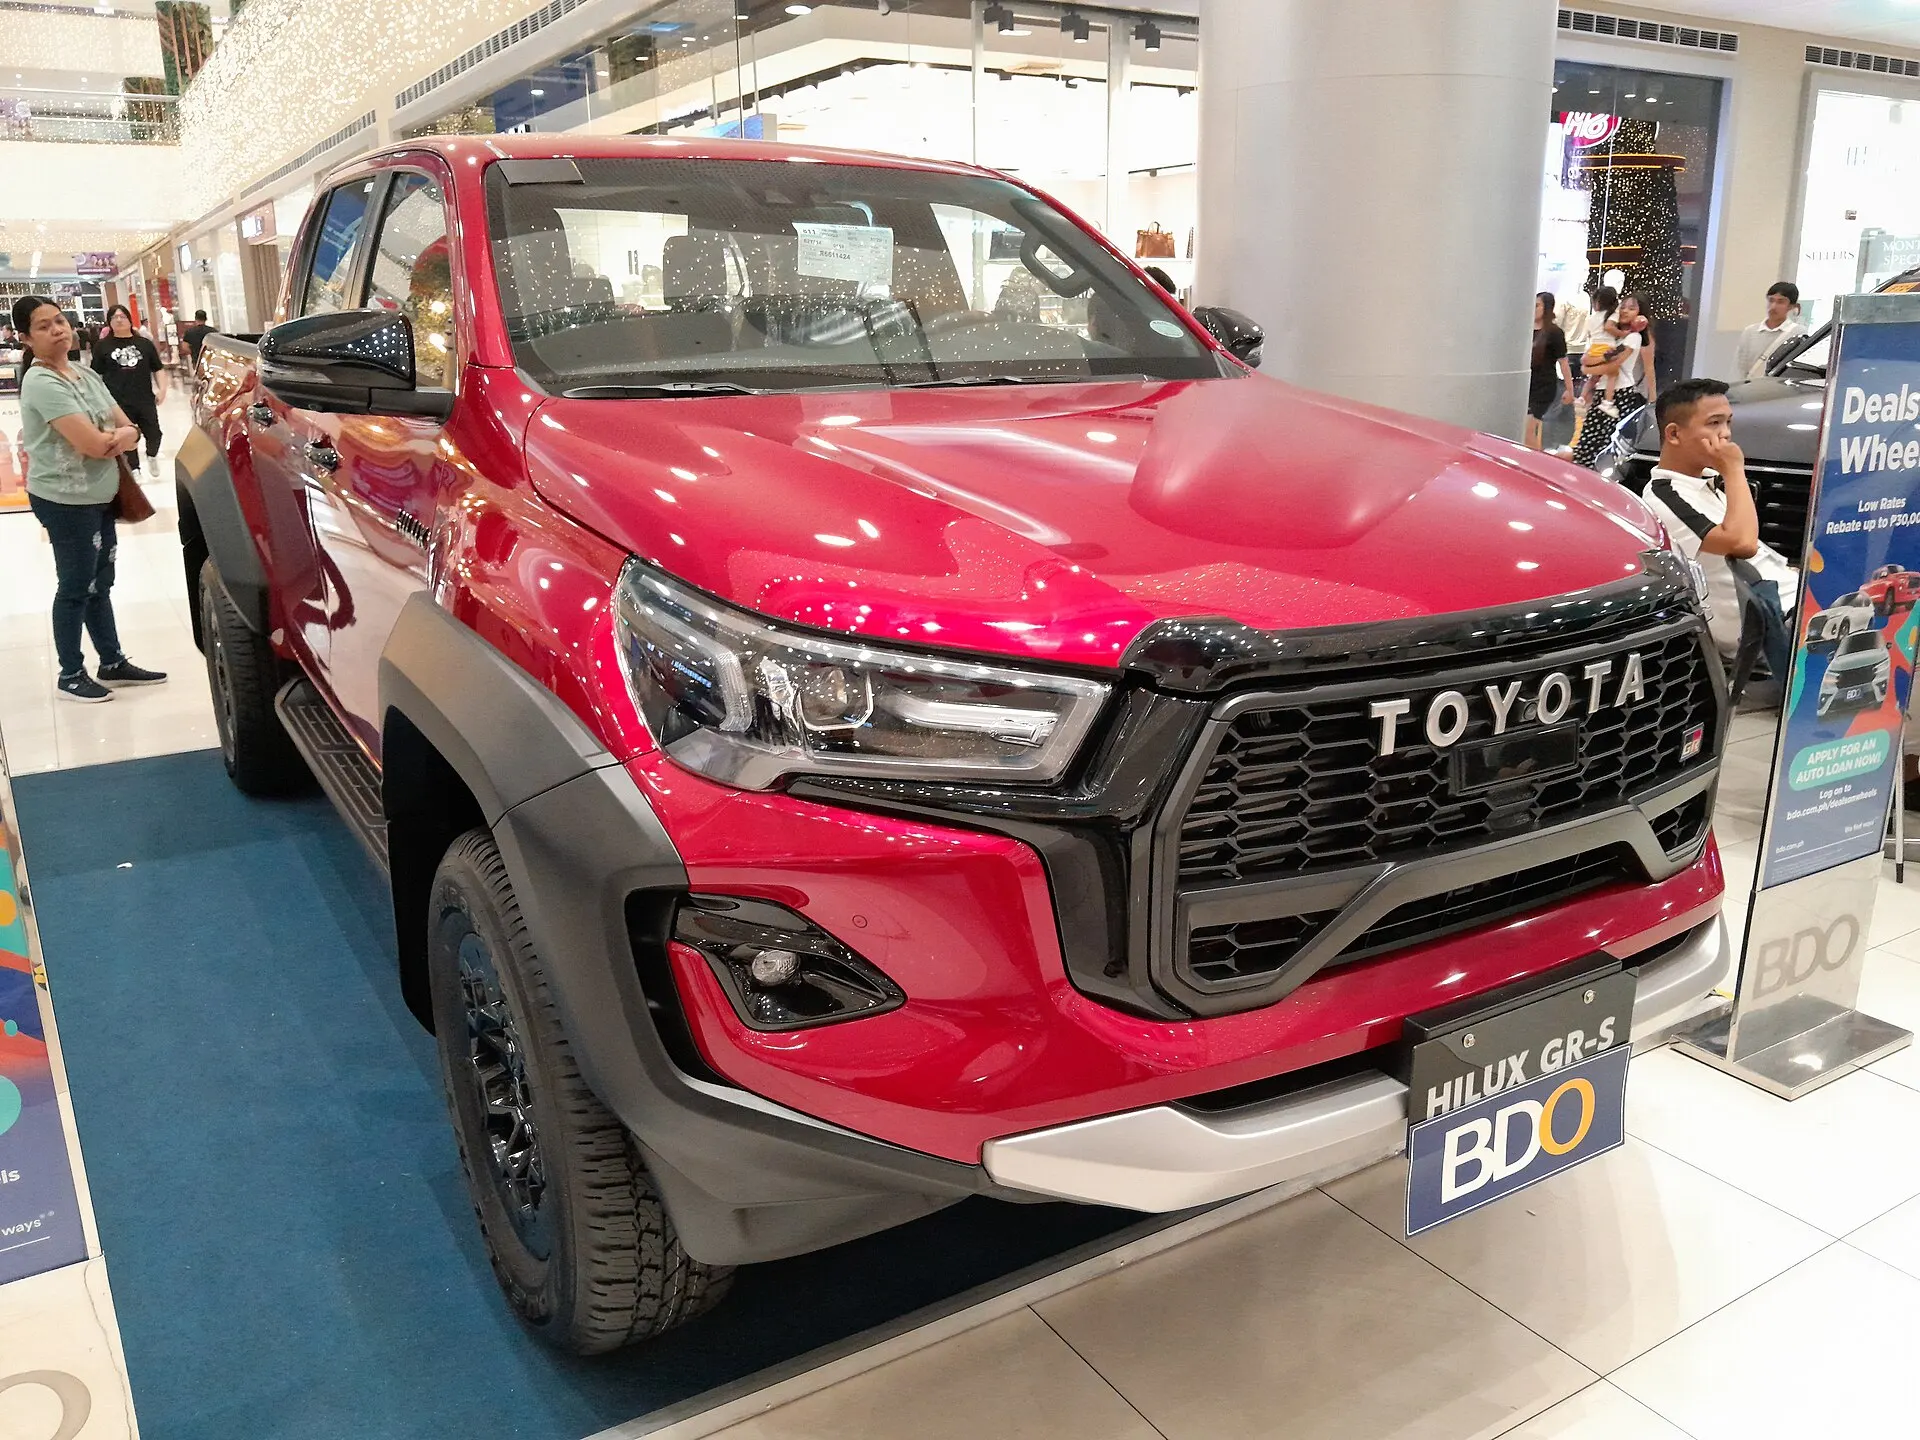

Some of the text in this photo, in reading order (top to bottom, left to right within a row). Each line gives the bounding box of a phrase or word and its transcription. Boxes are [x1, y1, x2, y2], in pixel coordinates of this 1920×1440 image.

[1842, 384, 1920, 424] Deals
[1840, 434, 1920, 475] Whee
[1857, 497, 1906, 512] Low Rates
[1826, 520, 1862, 535] Rebate
[1863, 520, 1877, 532] up
[1878, 516, 1889, 529] to
[1370, 653, 1645, 756] TOYOTA
[1807, 738, 1877, 766] APPLY FOR AN
[1795, 767, 1825, 784] AUTO
[1825, 759, 1854, 777] LOAN
[1819, 783, 1852, 800] Log on to
[1752, 913, 1861, 1000] BDO
[1426, 1016, 1617, 1120] HILUX GR-S
[1441, 1077, 1596, 1205] BDO
[0, 1168, 20, 1184] ls
[1, 1219, 42, 1236] ways
